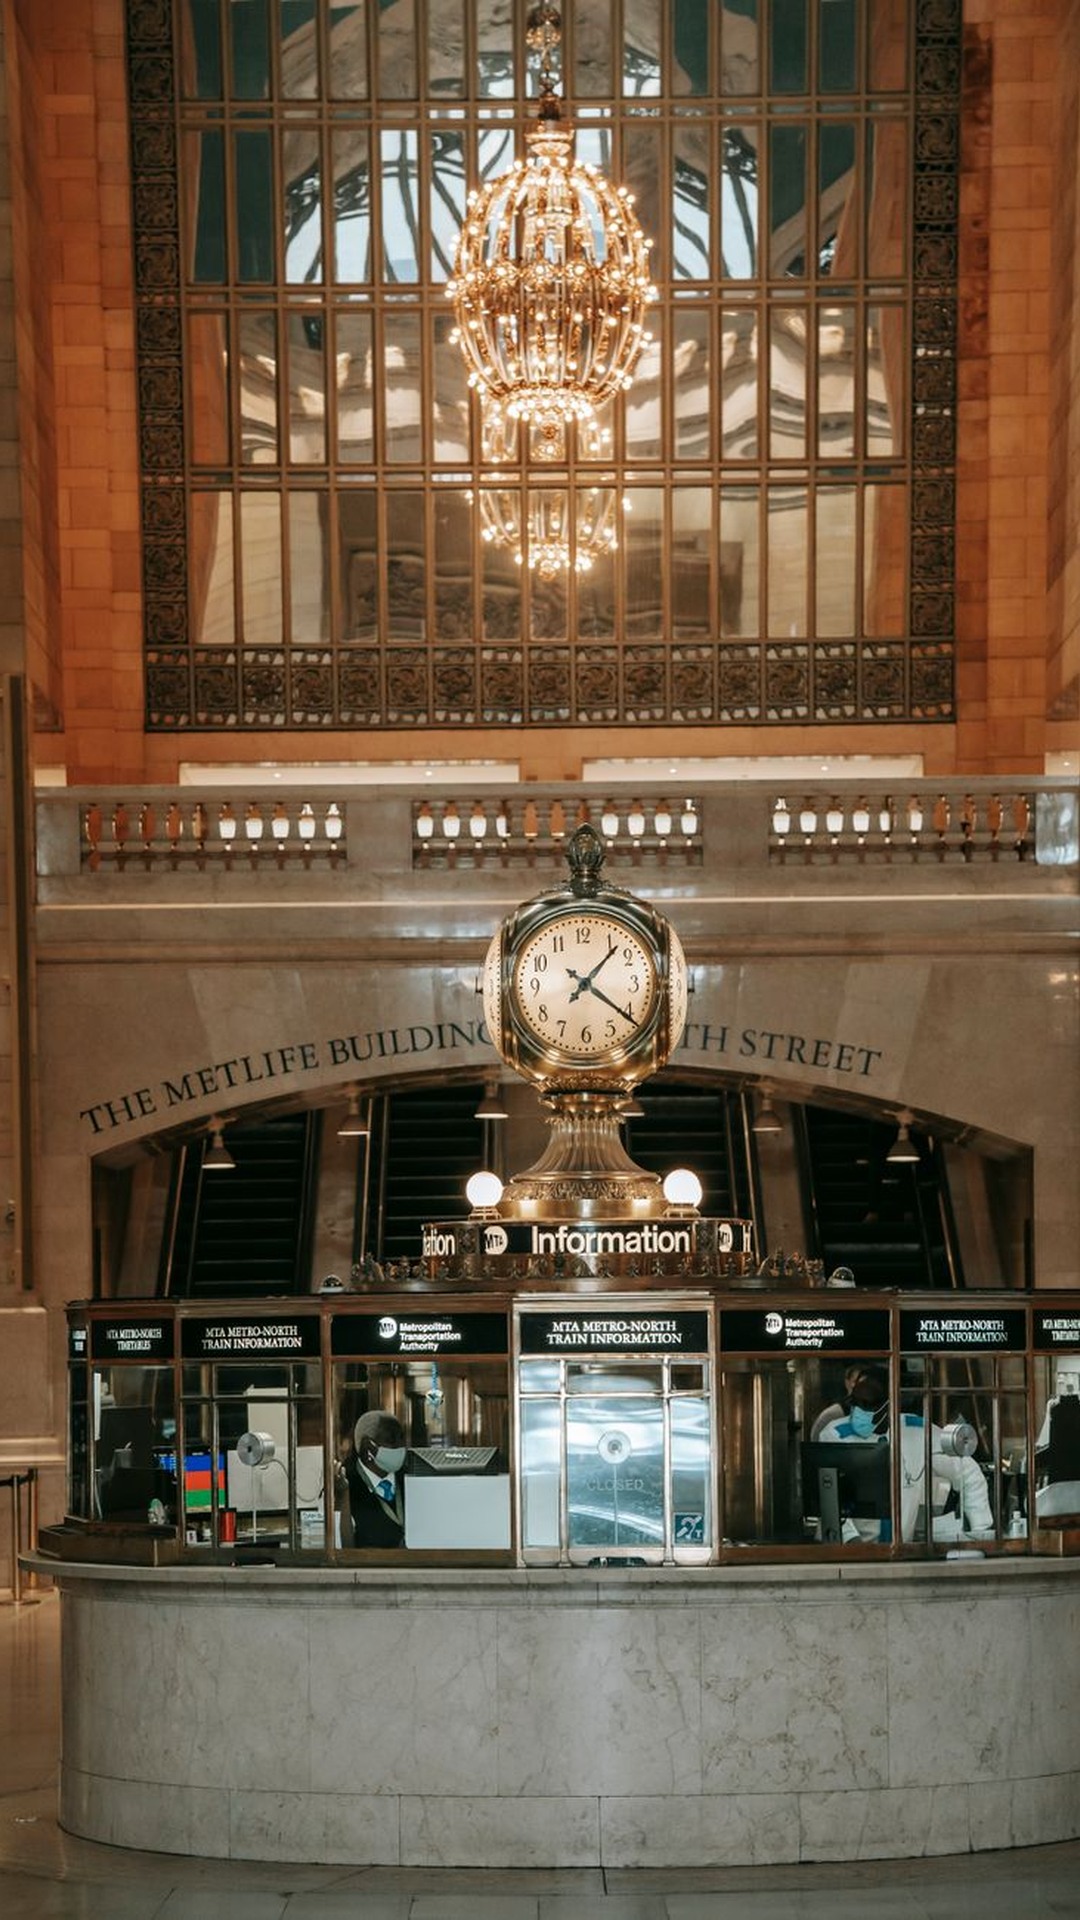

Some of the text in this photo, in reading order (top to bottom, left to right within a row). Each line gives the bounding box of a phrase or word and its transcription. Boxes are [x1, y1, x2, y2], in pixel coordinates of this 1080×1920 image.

[575, 926, 591, 944] 12
[606, 933, 613, 949] 1
[553, 935, 564, 953] 11
[534, 954, 547, 972] 10
[623, 948, 633, 966] 2
[530, 977, 540, 998] 9
[628, 974, 639, 993] 3
[538, 1004, 548, 1022] 8
[624, 1001, 634, 1019] 4
[556, 1020, 567, 1037] 7
[581, 1025, 592, 1044] 6
[604, 1020, 616, 1037] 5
[739, 1029, 882, 1076] STREET
[80, 1089, 157, 1134] THE
[161, 1043, 319, 1106] METLIFE
[531, 1225, 690, 1254] Information
[205, 1325, 298, 1338] MTA METRO-NORTH
[400, 1323, 452, 1333] Metropolitan
[552, 1321, 677, 1332] MTA METRO-NORTH
[785, 1318, 835, 1329] Metropolitan
[920, 1320, 1004, 1331] MTA METRO-NORTH
[399, 1332, 461, 1342] Transportation
[546, 1333, 682, 1345] TRAIN INFORMATION
[785, 1328, 844, 1338] Transportation
[916, 1332, 1008, 1342] TRAIN INFORMATION
[201, 1337, 302, 1350] TRAIN INFORMATION
[400, 1342, 439, 1352] Authority
[785, 1338, 823, 1348] Authority
[587, 1479, 644, 1491] CLOSED
